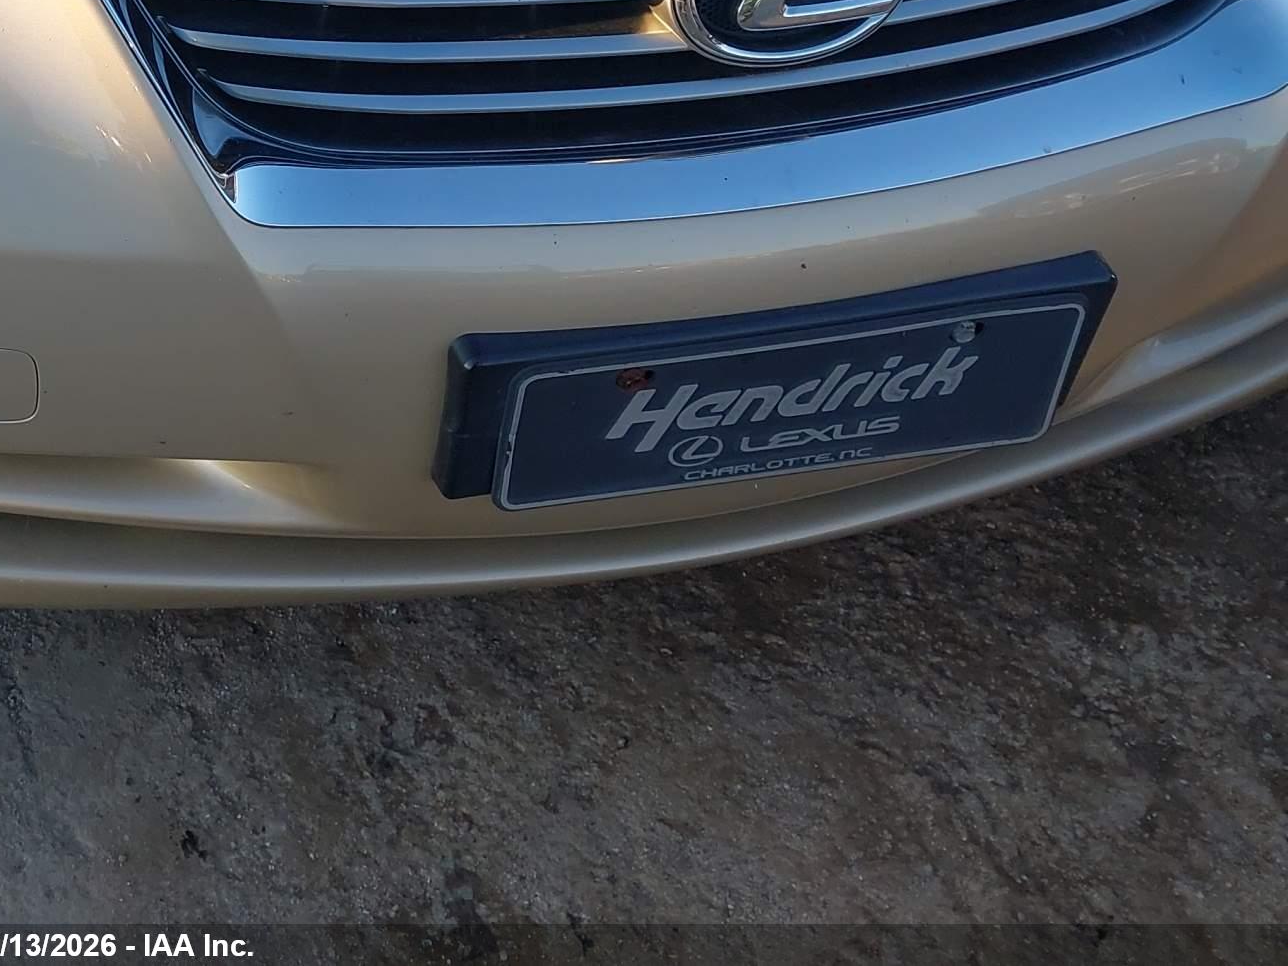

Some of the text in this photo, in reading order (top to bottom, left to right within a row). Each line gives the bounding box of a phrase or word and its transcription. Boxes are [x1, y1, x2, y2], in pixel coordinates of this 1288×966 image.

[605, 347, 978, 452] Hendrick
[740, 416, 900, 452] LEXUS
[839, 447, 873, 460] NC
